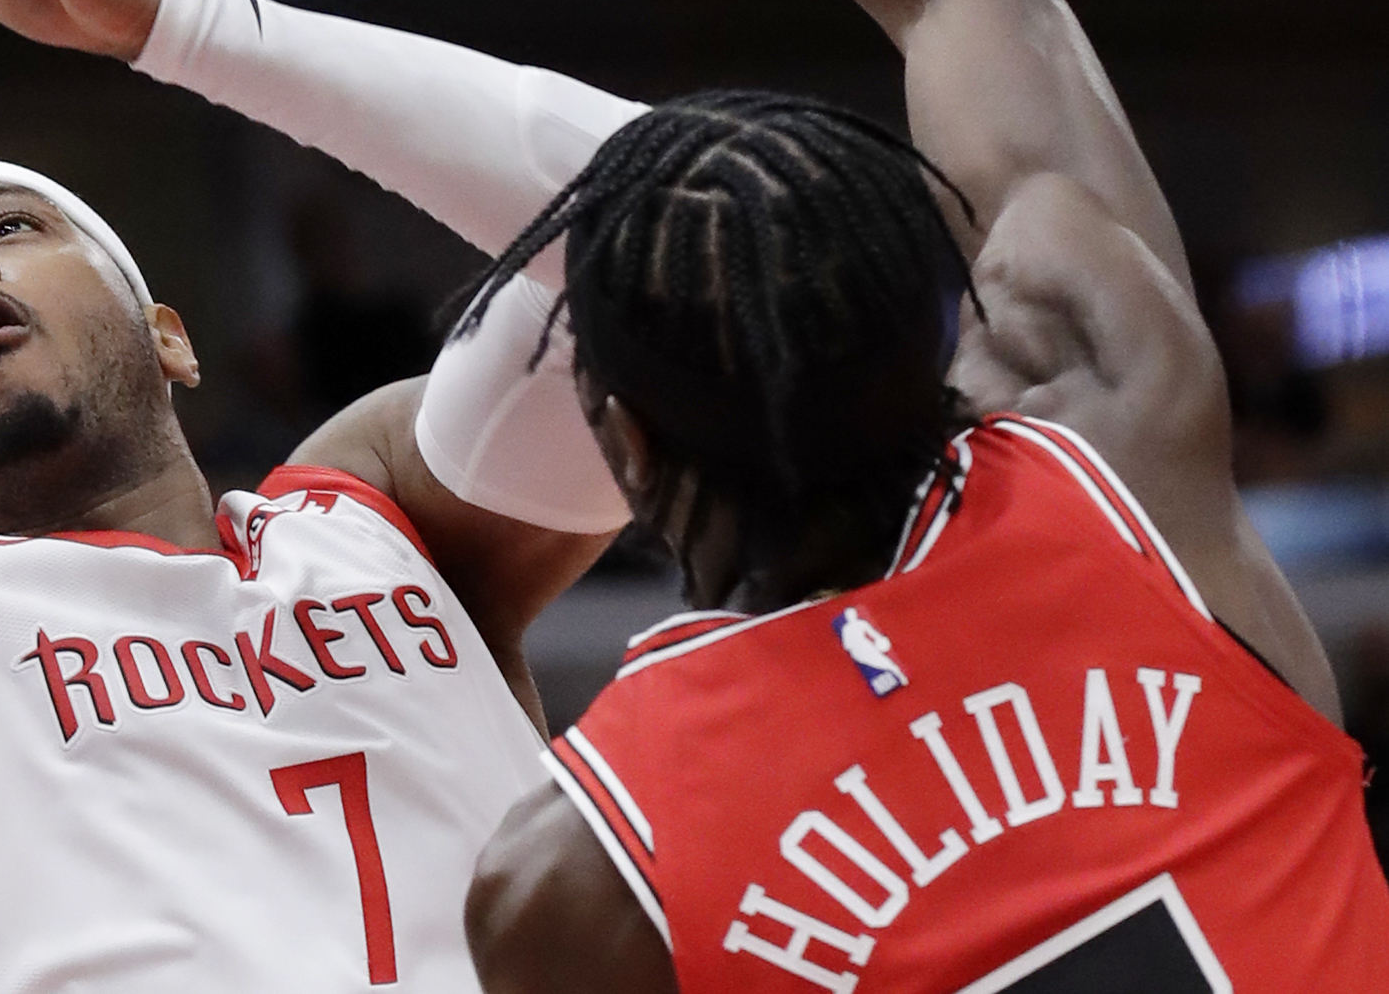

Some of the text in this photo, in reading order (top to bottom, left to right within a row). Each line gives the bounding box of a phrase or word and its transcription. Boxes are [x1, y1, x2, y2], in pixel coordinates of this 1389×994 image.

[17, 584, 460, 745] ROCKETS
[269, 751, 398, 985] 7
[722, 666, 1202, 994] HOLIDAY
